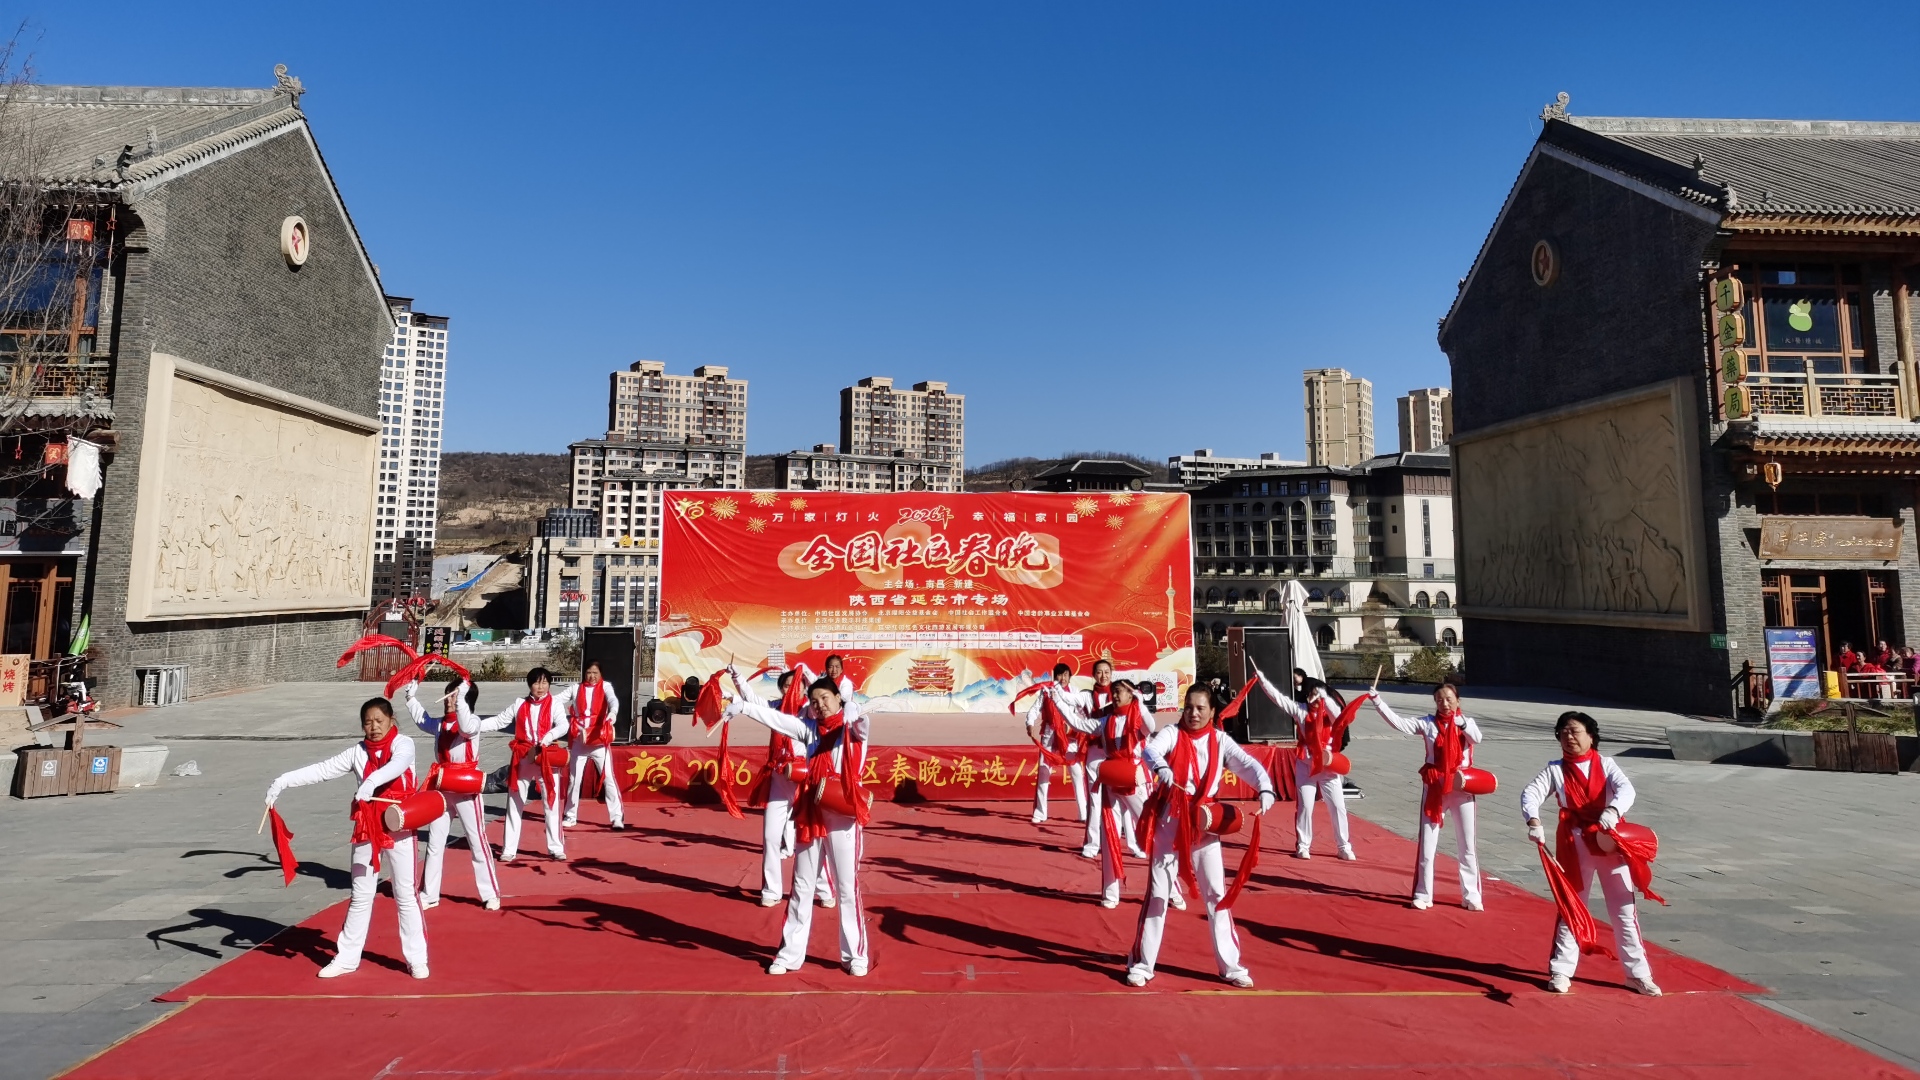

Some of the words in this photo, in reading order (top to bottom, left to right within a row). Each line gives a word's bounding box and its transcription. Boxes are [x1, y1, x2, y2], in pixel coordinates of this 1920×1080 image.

[897, 504, 955, 530] 2026年
[796, 530, 1053, 578] 全国社区春晚
[848, 593, 1009, 607] 陕西省延安市专场
[2, 668, 16, 693] 烧烤
[686, 759, 752, 786] 206
